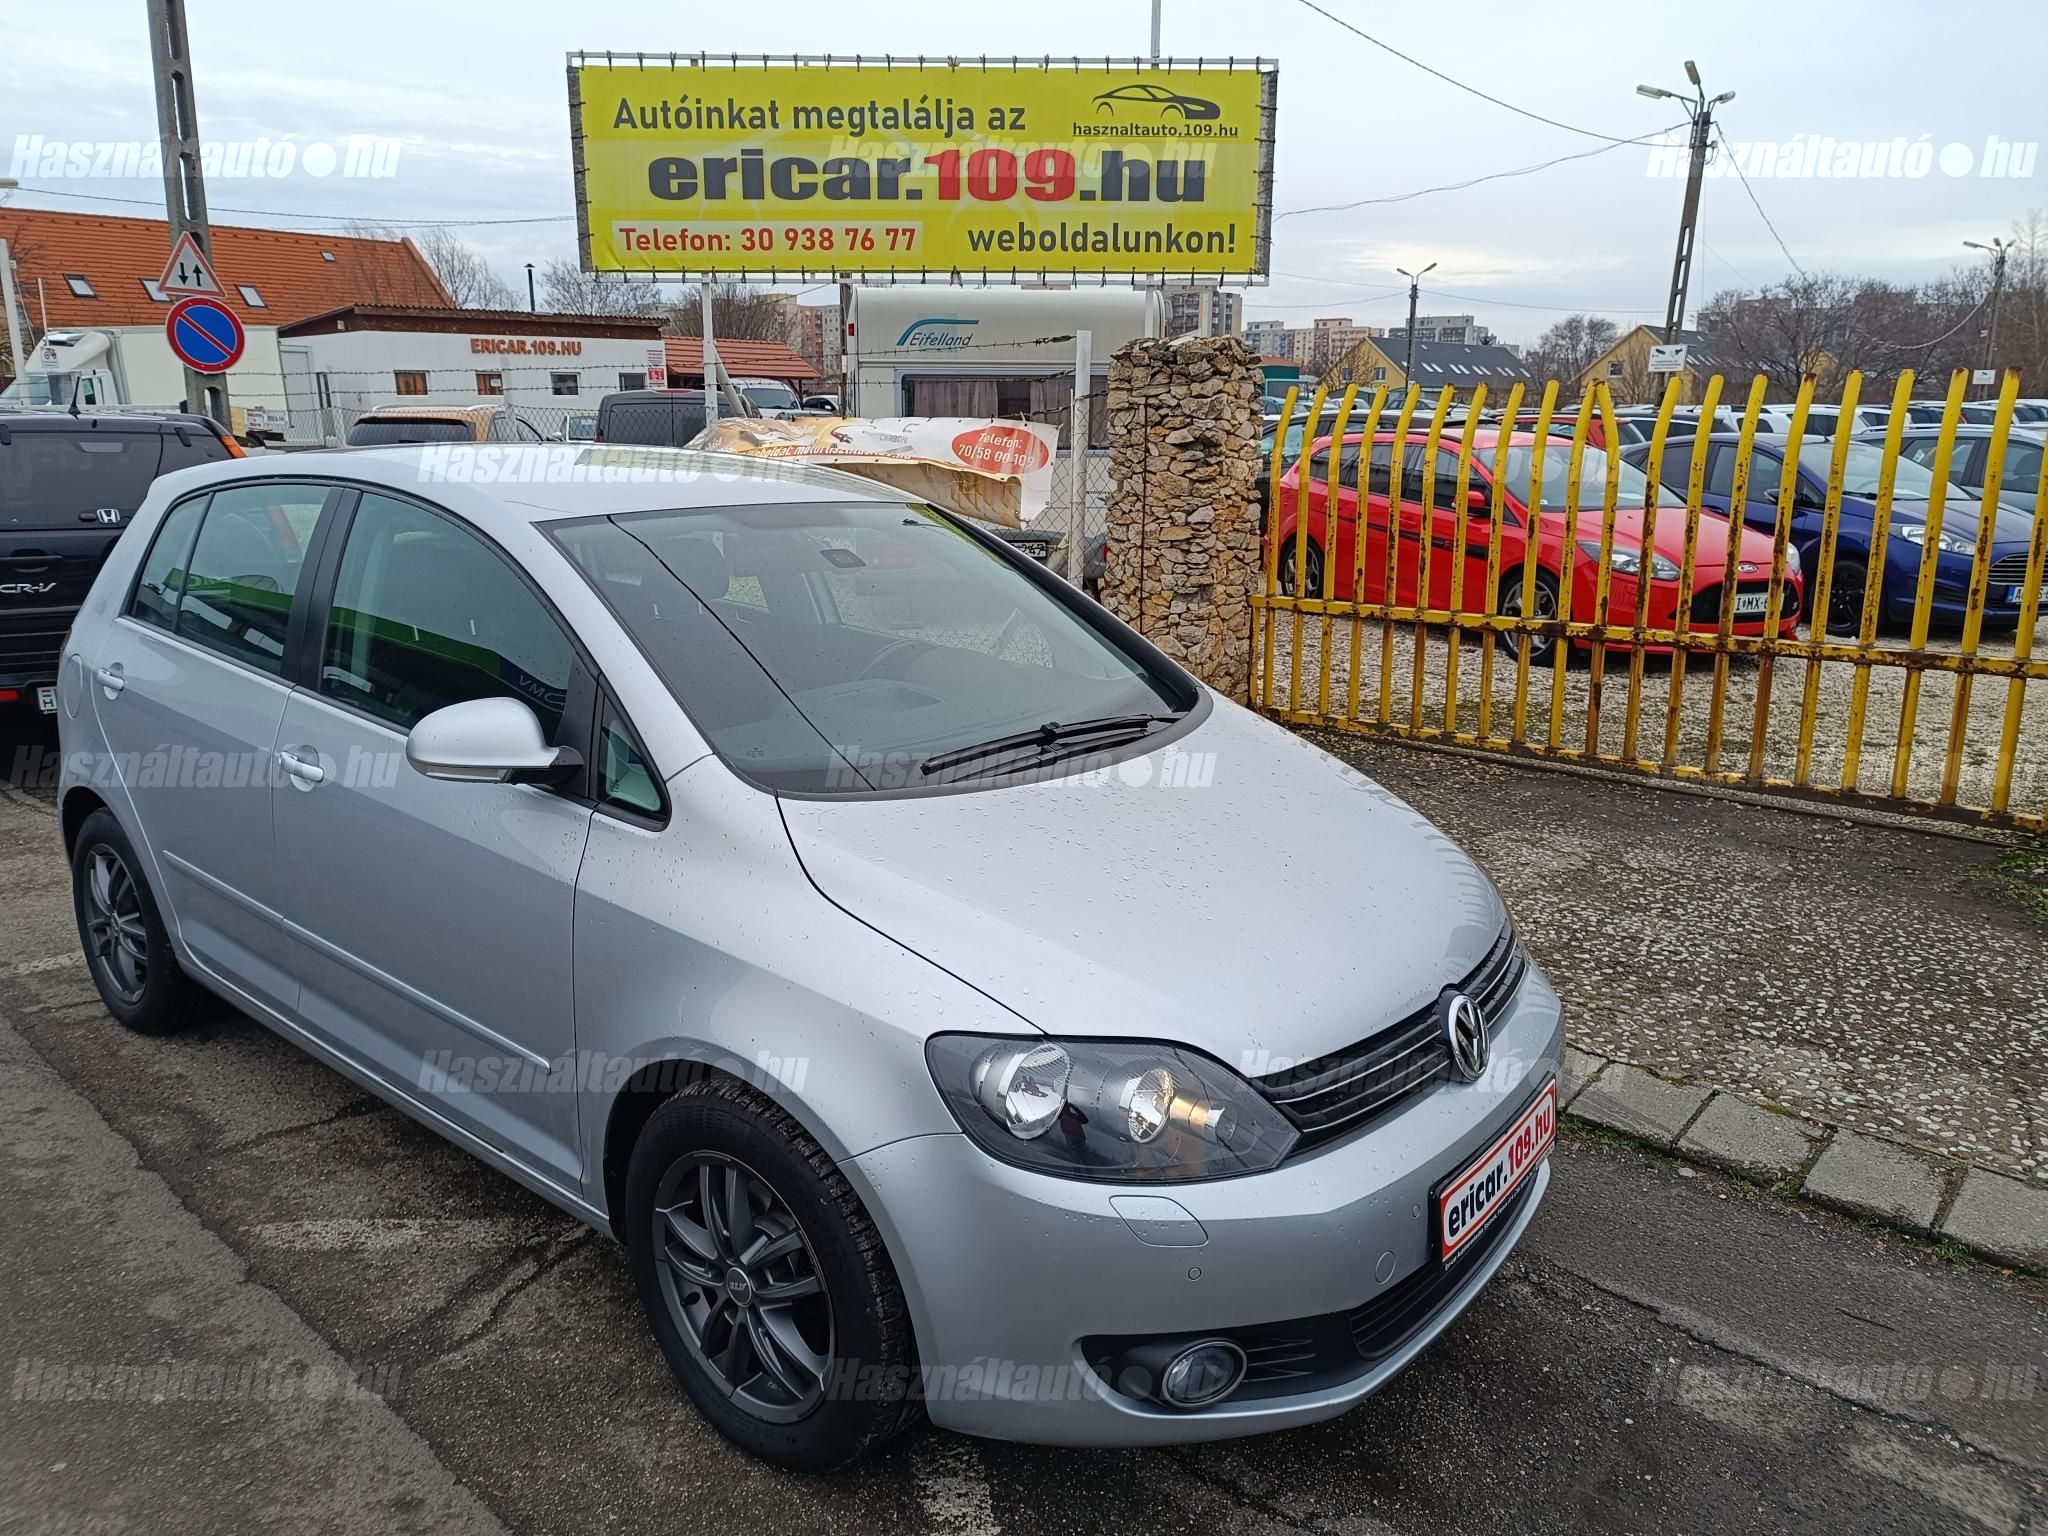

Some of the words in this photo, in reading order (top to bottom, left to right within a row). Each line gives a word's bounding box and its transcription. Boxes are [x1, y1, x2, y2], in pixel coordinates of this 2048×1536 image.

[613, 94, 779, 129] Autóinkat
[793, 94, 974, 138] megtalálja
[987, 106, 1026, 130] az
[1072, 122, 1239, 137] hasznaltauto.109.hu
[648, 148, 1206, 202] ericar.109.hu
[619, 228, 731, 251] Telefon:
[741, 228, 773, 251] 30
[785, 228, 834, 251] 938
[845, 228, 875, 251] 76
[885, 228, 916, 251] 77
[968, 222, 1236, 254] weboldalunkon!
[470, 338, 582, 356] ERICAR.109.HU
[909, 332, 974, 347] Eifelland
[979, 433, 1023, 449] Telefon:
[958, 445, 992, 460] 70/58
[994, 450, 1011, 464] 00
[1013, 453, 1035, 468] 109
[0, 582, 57, 594] CR-V
[1448, 1104, 1550, 1237] ericar.109.hu
